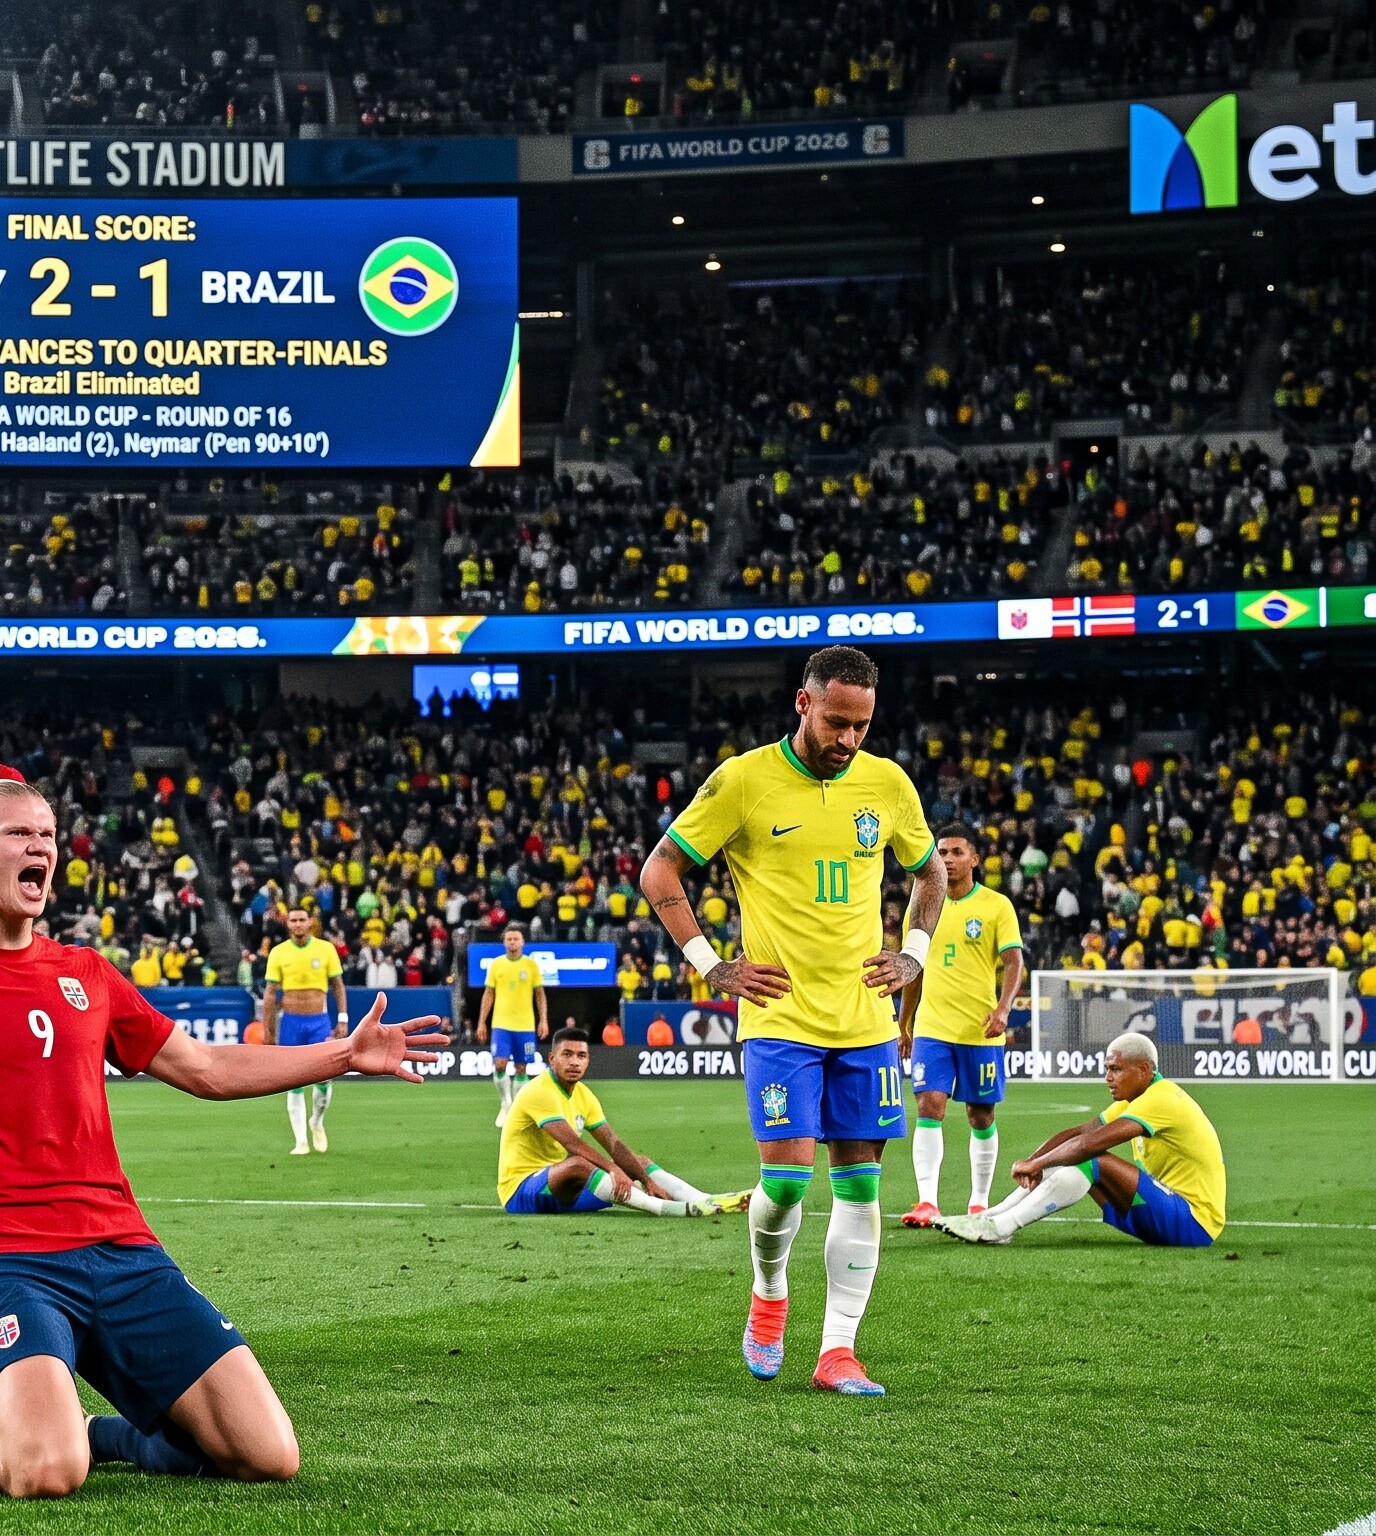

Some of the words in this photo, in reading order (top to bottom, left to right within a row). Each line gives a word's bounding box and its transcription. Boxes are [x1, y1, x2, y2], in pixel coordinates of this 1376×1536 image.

[619, 142, 664, 161] FIFA
[667, 138, 743, 158] WORLD
[747, 135, 790, 155] CUP
[794, 131, 850, 152] 2026
[106, 141, 285, 187] STADIUM
[7, 214, 90, 240] FINAL
[94, 215, 197, 241] SCORE:
[29, 256, 72, 317] 2
[90, 284, 117, 298] -
[138, 258, 169, 318] 1
[201, 270, 336, 304] BRAZIL
[98, 339, 138, 366] TO
[144, 340, 388, 368] QUARTER-FINALS
[3, 370, 71, 395] Brazil
[76, 371, 200, 396] Eliminated
[15, 405, 91, 427] WORLD
[94, 406, 139, 427] CUP
[141, 414, 152, 422] -
[156, 406, 229, 427] ROUND
[233, 406, 262, 427] OF
[266, 406, 292, 427] 16
[0, 432, 81, 452] Haaland
[85, 432, 120, 458] (2),
[124, 432, 200, 458] Neymar
[204, 432, 251, 458] (Pen
[254, 432, 330, 458] 90+10')
[1156, 598, 1209, 628] 2-1
[103, 626, 168, 649] CUP
[173, 626, 267, 649] 2026.
[564, 621, 631, 645] FIFA
[636, 617, 749, 643] WORLD
[753, 614, 820, 640] CUP
[827, 611, 925, 637] 2026.
[815, 860, 848, 903] 10
[944, 943, 956, 967] 2
[28, 1009, 54, 1058] 9
[638, 1050, 689, 1075] 2026
[692, 1050, 737, 1075] FIFA
[1194, 1050, 1251, 1076] 2026
[877, 1066, 902, 1107] 10
